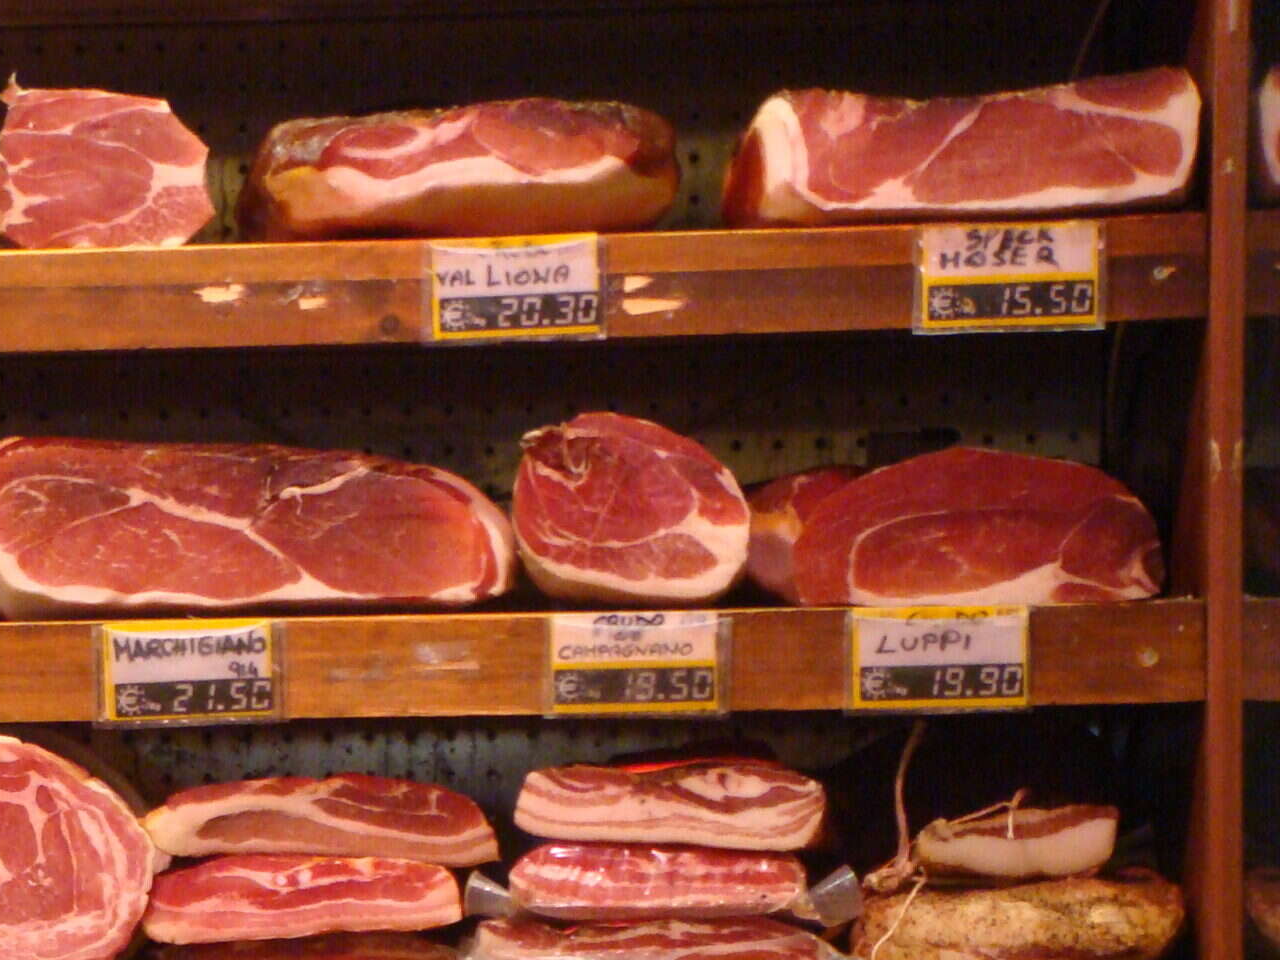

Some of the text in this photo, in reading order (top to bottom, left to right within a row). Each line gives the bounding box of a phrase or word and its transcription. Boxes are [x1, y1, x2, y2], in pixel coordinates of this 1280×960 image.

[497, 294, 598, 327] 20.30
[1001, 283, 1092, 315] 15.50
[113, 630, 267, 662] MARCHIGIANO
[875, 630, 972, 654] LUPPI
[172, 680, 270, 713] 21.50
[932, 666, 1022, 697] 19.90
